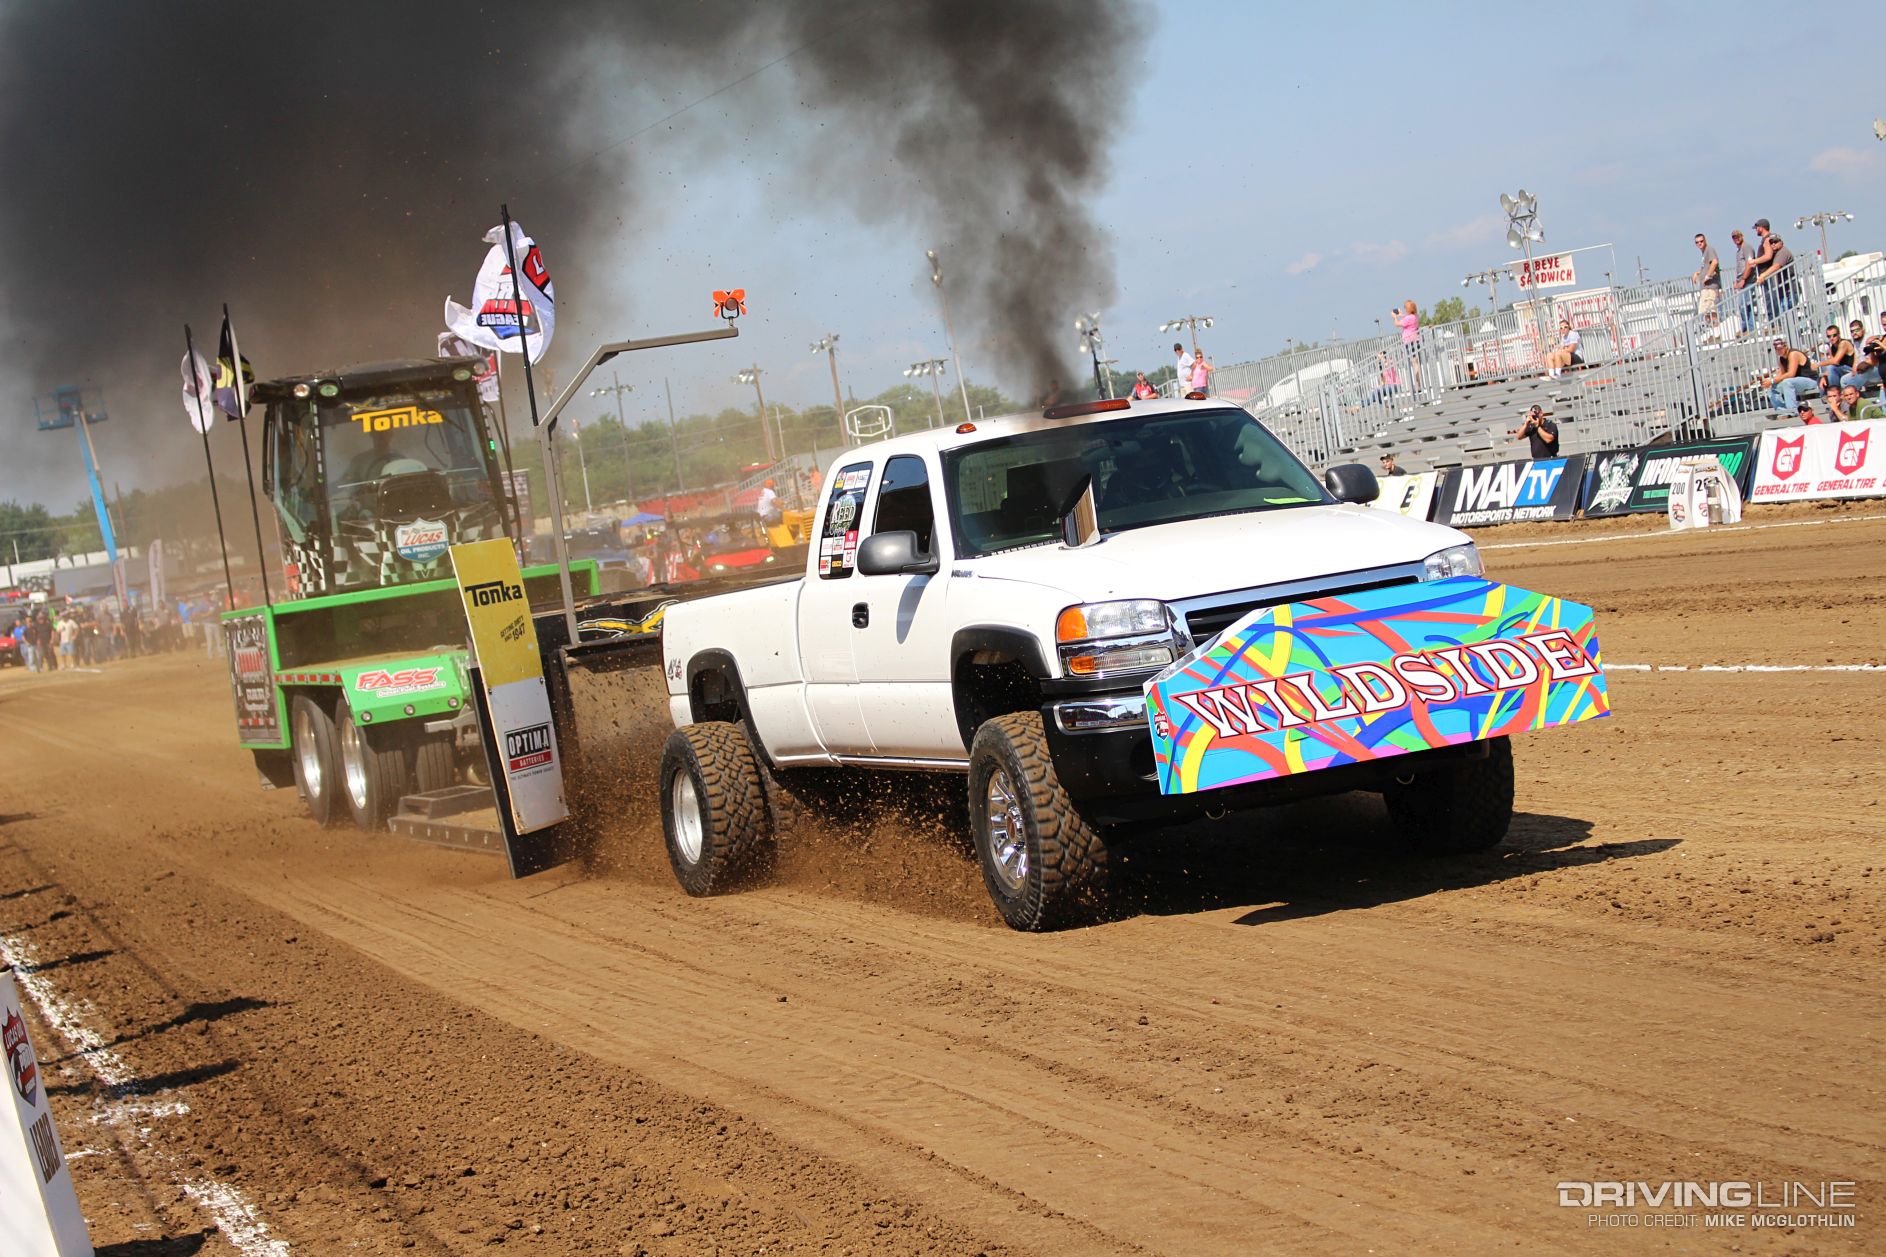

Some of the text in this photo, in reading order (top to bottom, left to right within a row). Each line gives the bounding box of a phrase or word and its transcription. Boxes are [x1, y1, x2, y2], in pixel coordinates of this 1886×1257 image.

[1523, 256, 1560, 273] RBEYE
[351, 406, 443, 433] Tonka
[1776, 446, 1801, 473] GT
[1839, 440, 1866, 467] GT
[1672, 482, 1685, 495] 200
[1754, 482, 1810, 496] GENERAL TIRE
[1817, 479, 1853, 492] GENERAL
[1854, 478, 1877, 489] TIRE
[1450, 505, 1556, 524] MOTORSPORTS NETWORK
[403, 531, 443, 546] LUCAS
[464, 580, 523, 607] Tonka
[357, 667, 437, 689] FASS
[1172, 629, 1601, 739] WILDSIDE
[508, 728, 549, 756] OPTIMA
[519, 754, 545, 767] BATTERIES
